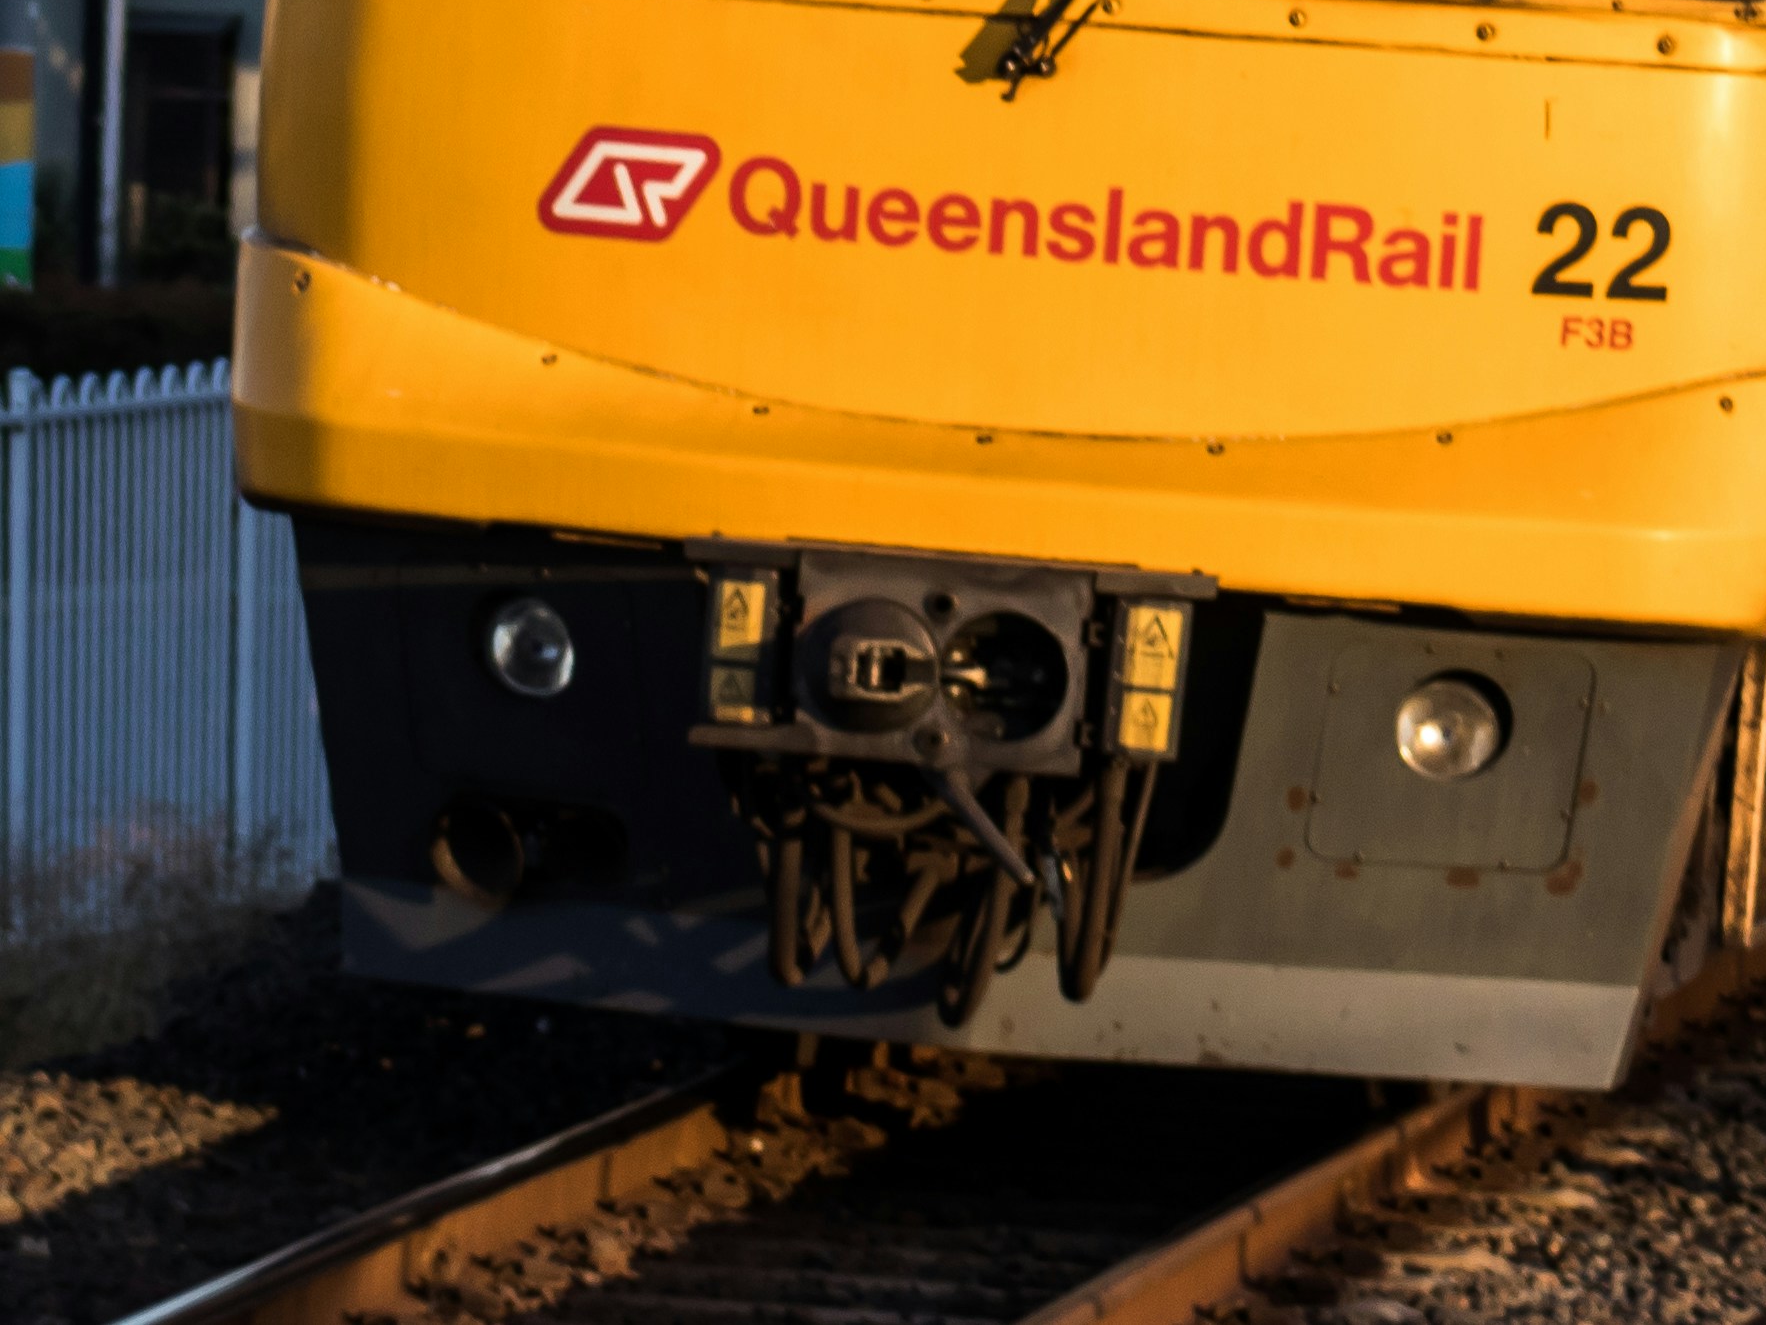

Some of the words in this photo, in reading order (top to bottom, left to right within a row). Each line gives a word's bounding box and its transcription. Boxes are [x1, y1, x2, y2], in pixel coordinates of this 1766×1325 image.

[728, 155, 1484, 293] QueenslandRail
[1531, 201, 1671, 302] 22
[1560, 316, 1634, 351] F3B
